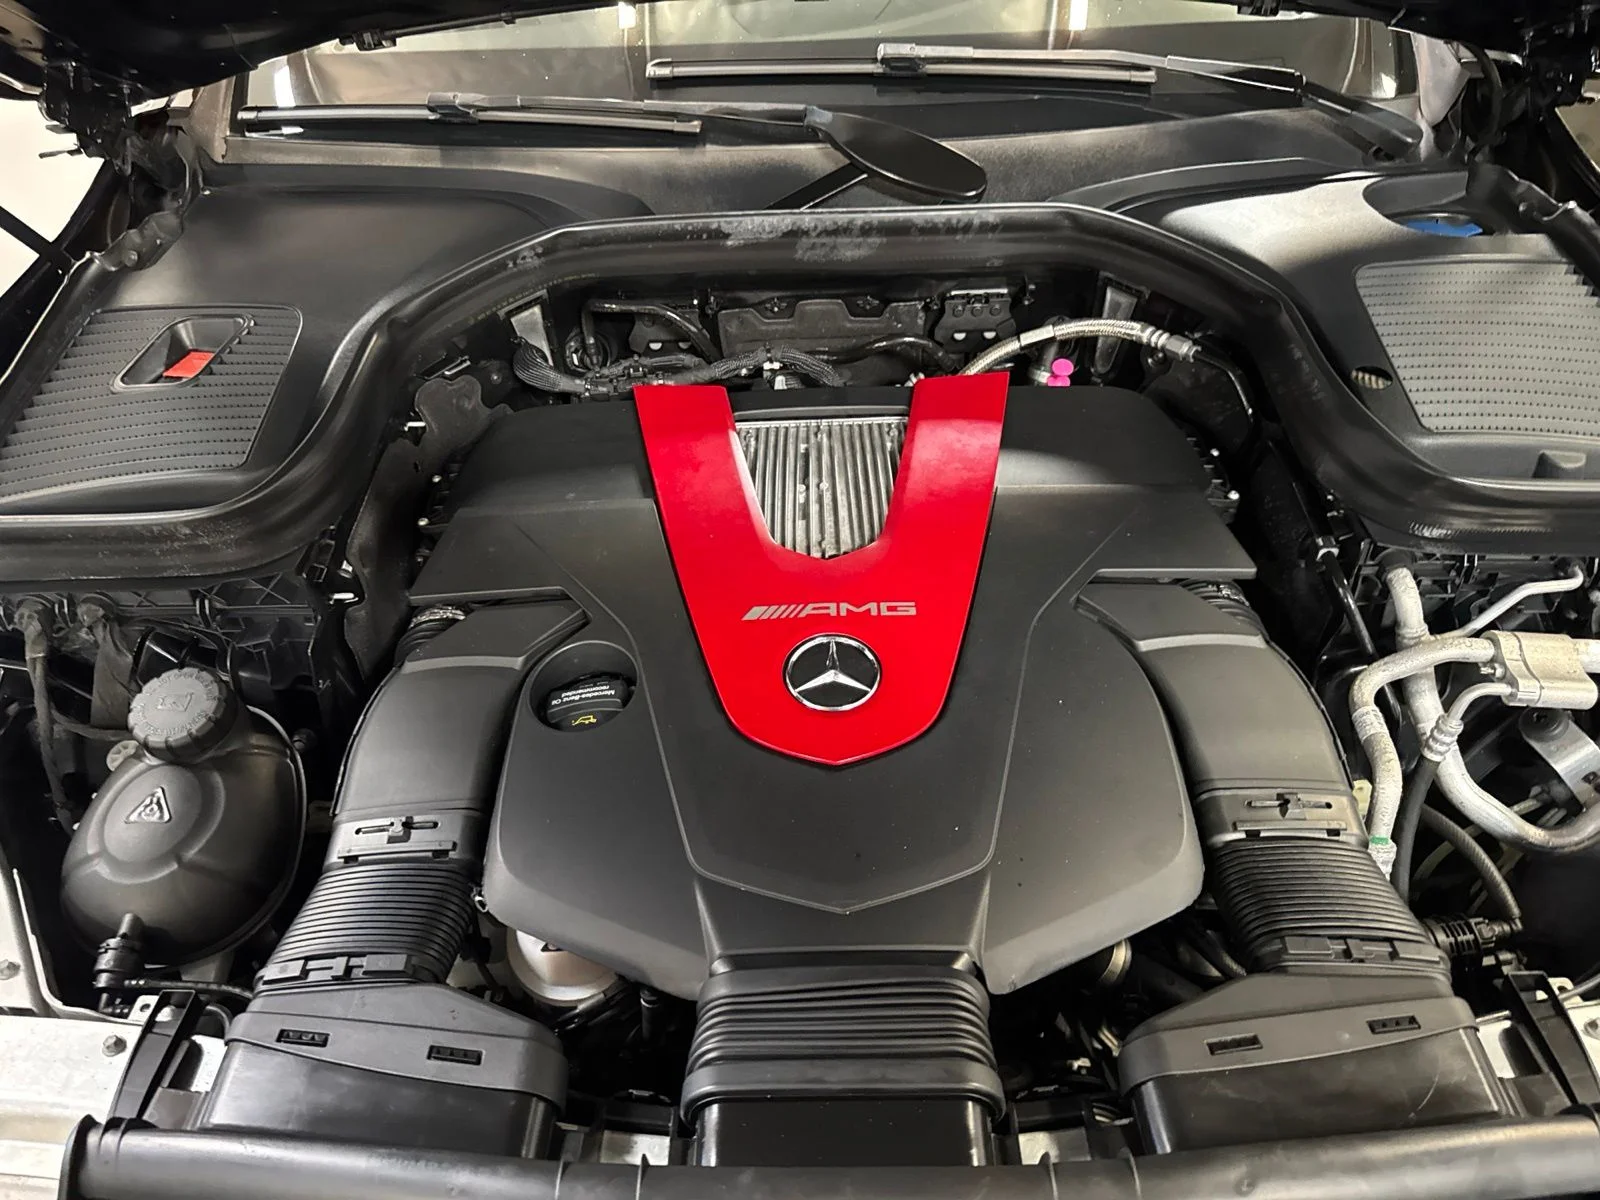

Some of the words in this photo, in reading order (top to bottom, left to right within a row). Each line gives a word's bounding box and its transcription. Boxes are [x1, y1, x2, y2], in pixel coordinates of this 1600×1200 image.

[798, 602, 917, 618] AMG
[561, 685, 610, 697] recommended
[563, 690, 615, 702] Mercedes-Benz
